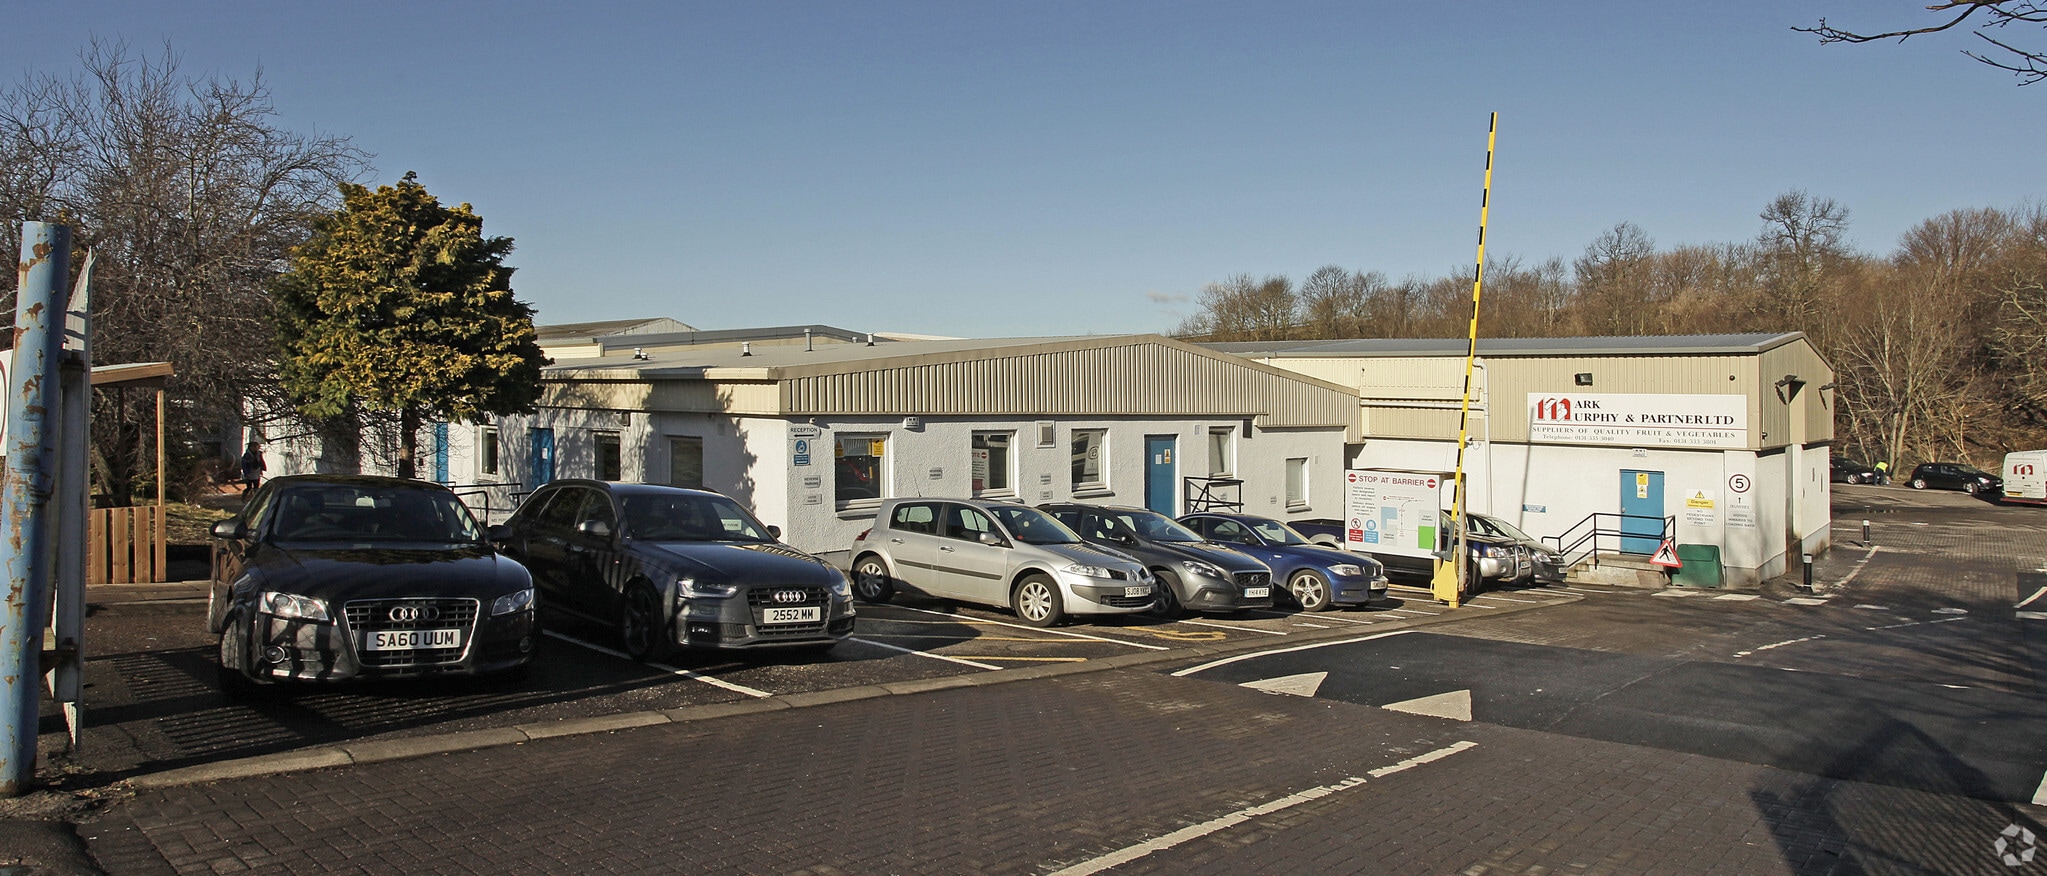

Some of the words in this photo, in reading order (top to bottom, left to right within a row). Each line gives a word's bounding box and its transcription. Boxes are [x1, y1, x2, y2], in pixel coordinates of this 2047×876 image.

[1574, 400, 1601, 410] ARK
[1574, 412, 1620, 423] URPHY
[1625, 413, 1635, 423] &
[1532, 426, 1574, 434] SUPPLIERS
[1593, 427, 1632, 436] QUALITY
[1636, 429, 1661, 437] FRUIT
[1676, 430, 1736, 439] VEGETABLES
[1358, 475, 1378, 483] STOP
[1392, 477, 1425, 487] BARRIER
[1735, 478, 1744, 489] 5
[773, 609, 799, 621] 2552
[801, 609, 814, 620] MM
[376, 632, 419, 647] SA60
[424, 631, 454, 646] UUM
